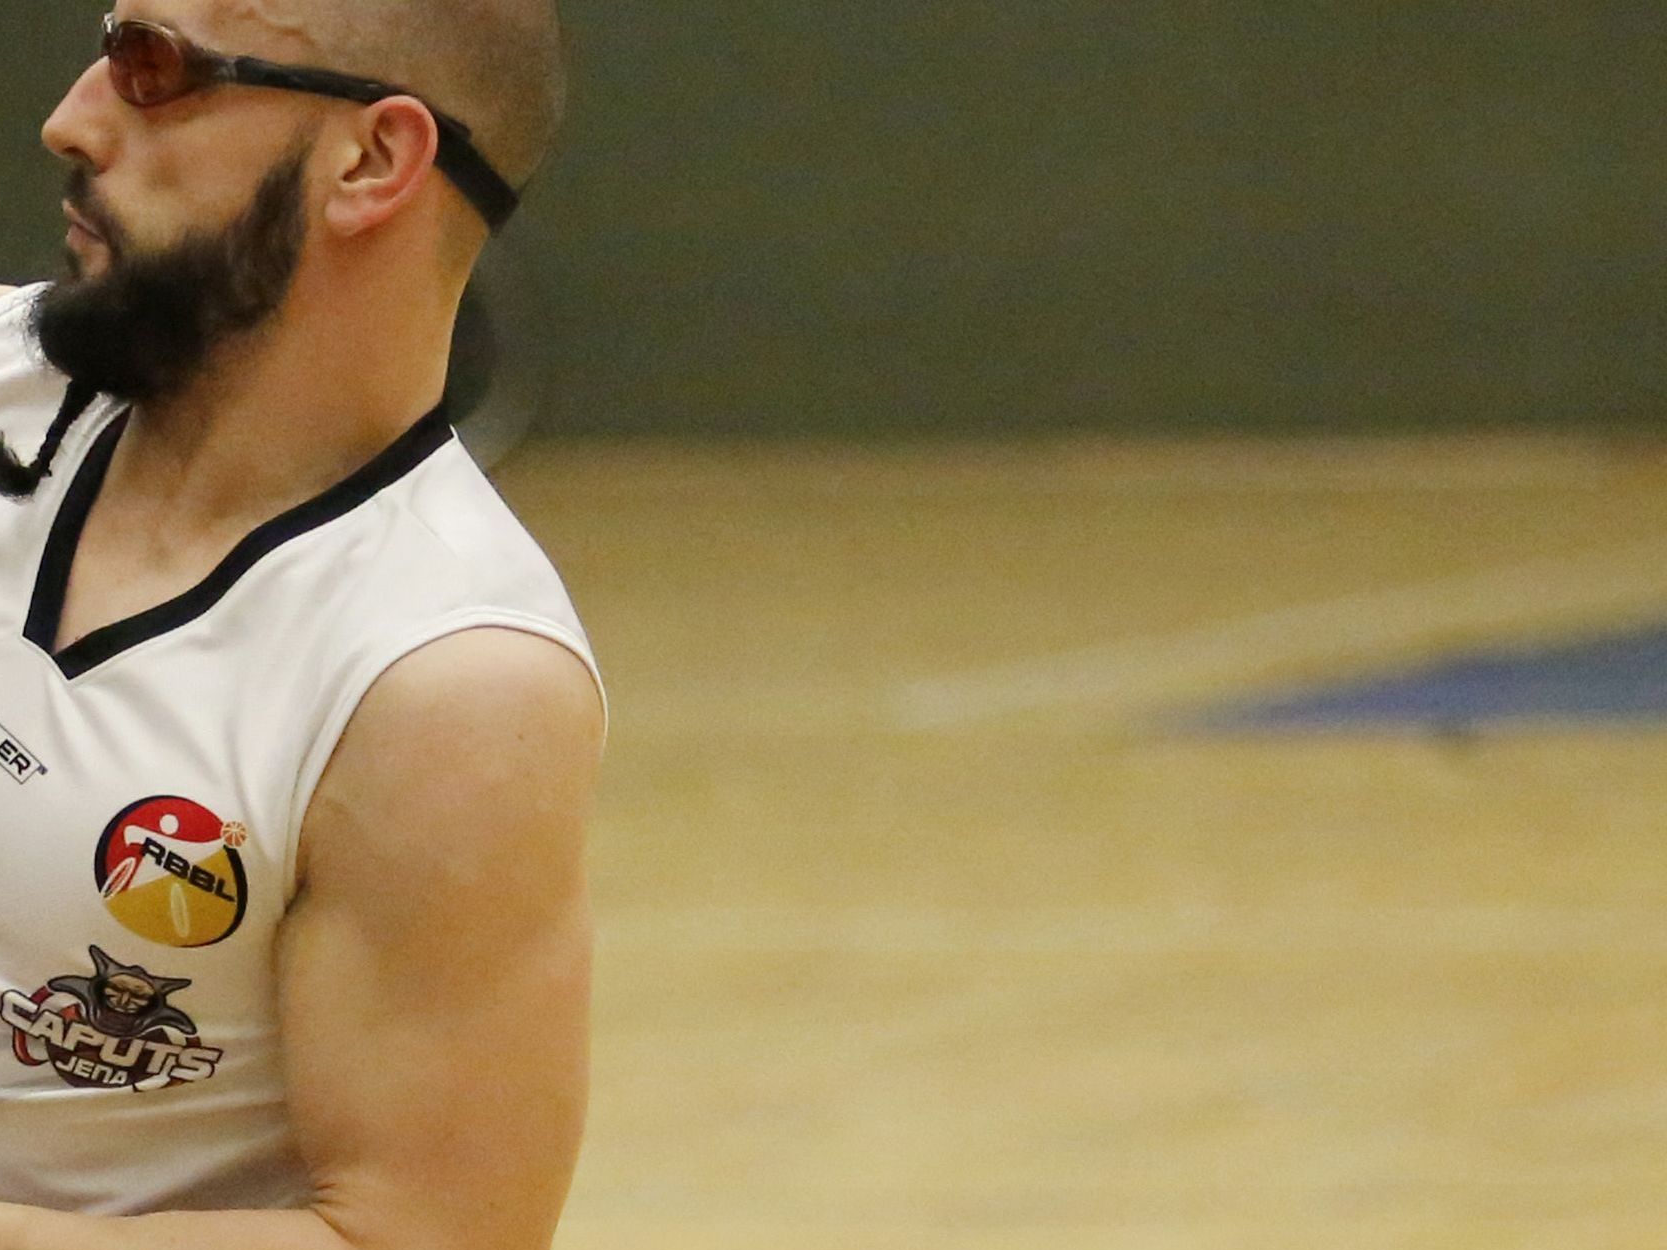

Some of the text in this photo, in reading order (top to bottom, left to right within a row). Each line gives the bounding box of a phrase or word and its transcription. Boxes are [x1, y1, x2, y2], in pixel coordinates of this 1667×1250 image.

[143, 837, 235, 902] RBBL
[0, 989, 224, 1080] CAPUTS
[56, 1055, 128, 1085] JENA
